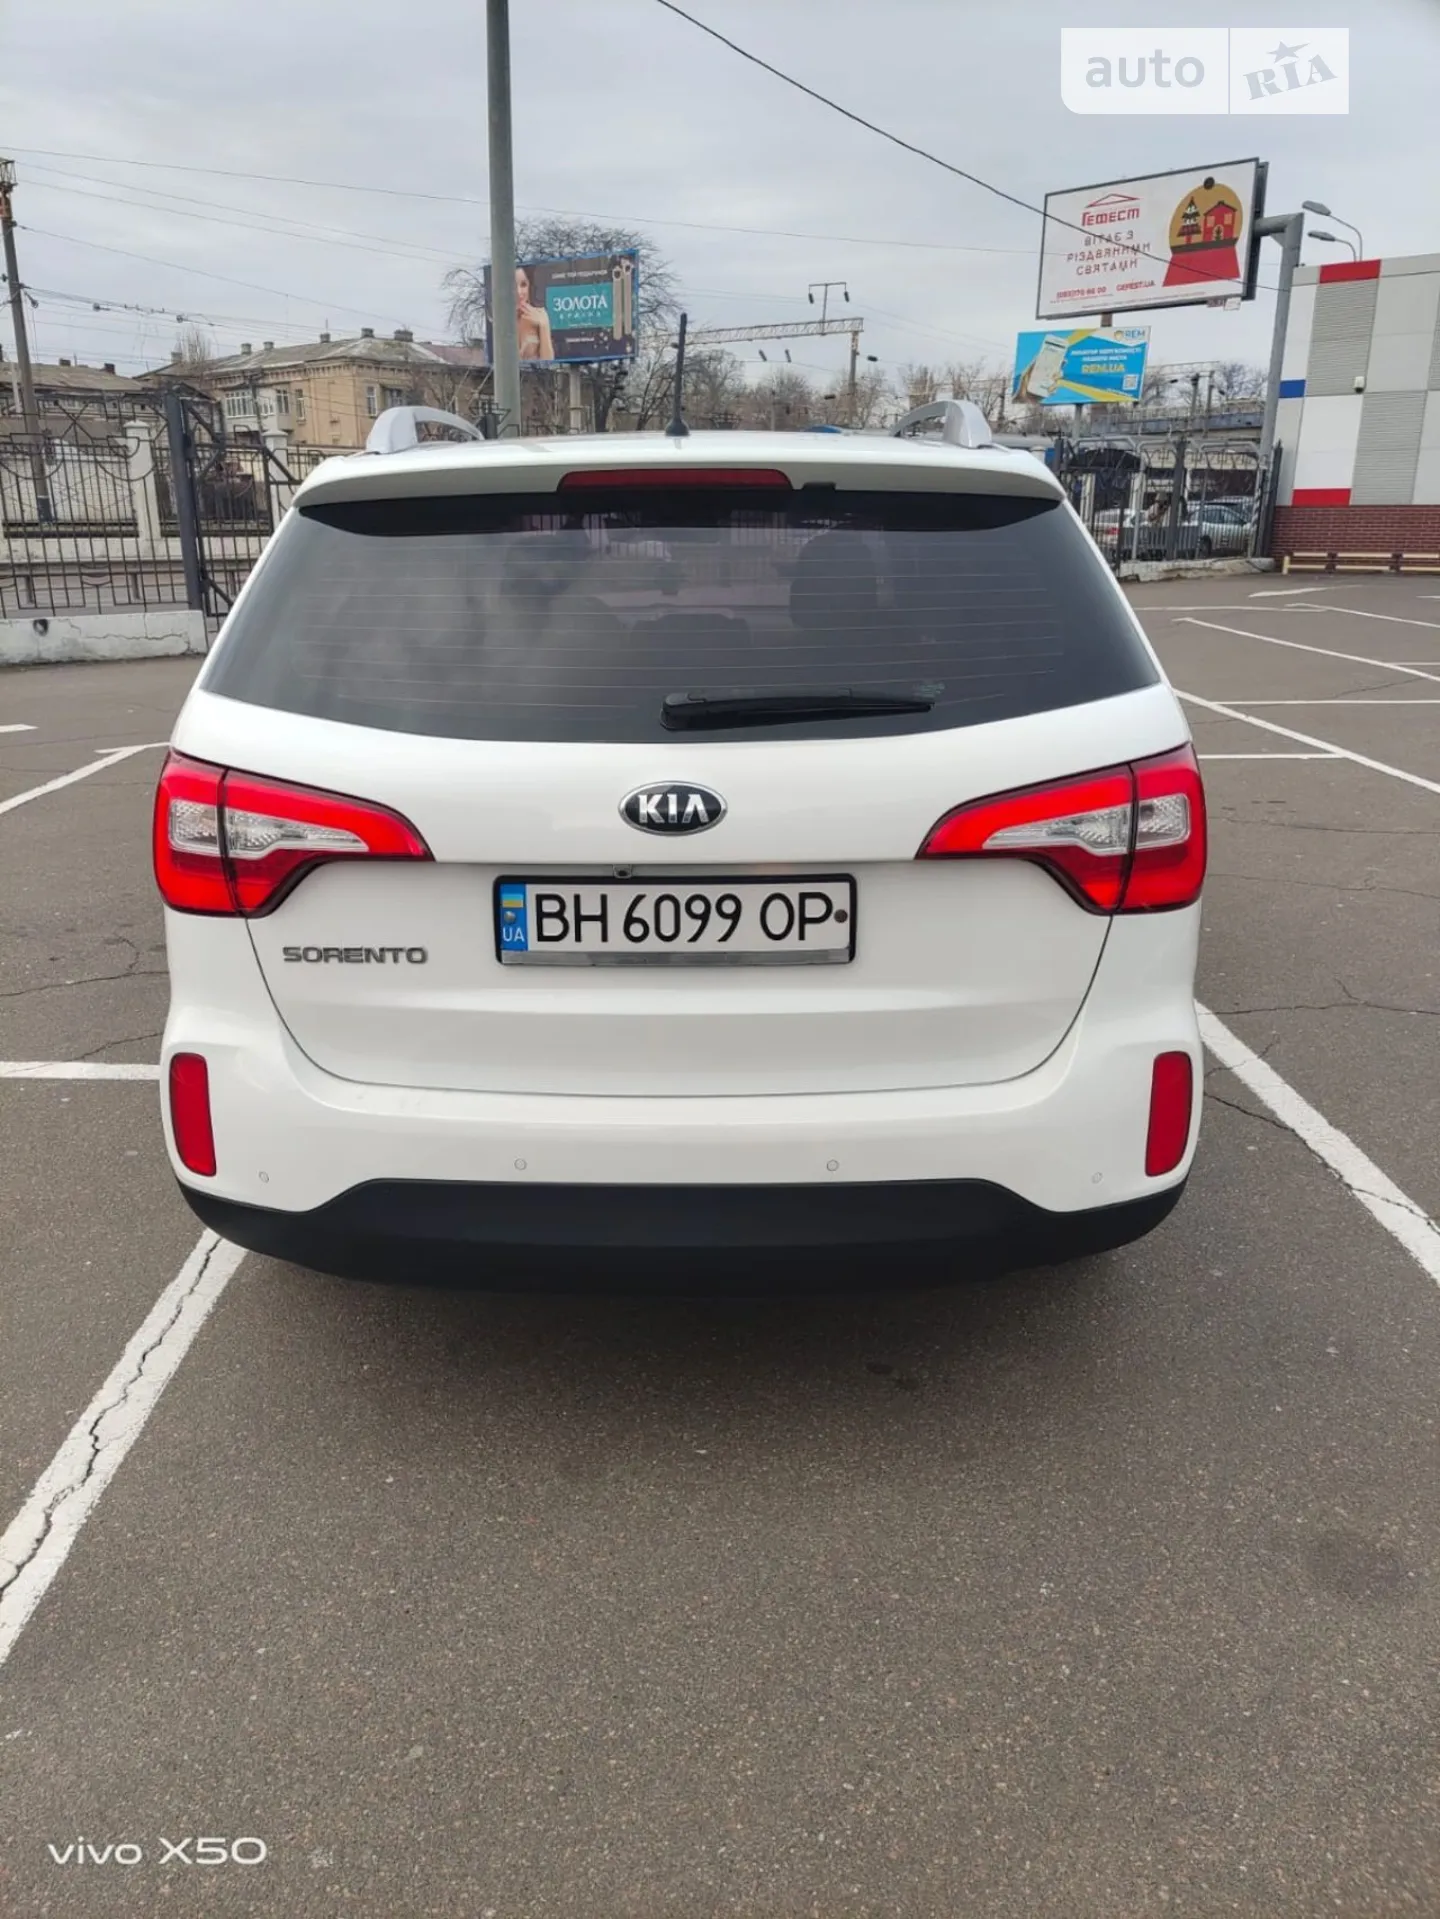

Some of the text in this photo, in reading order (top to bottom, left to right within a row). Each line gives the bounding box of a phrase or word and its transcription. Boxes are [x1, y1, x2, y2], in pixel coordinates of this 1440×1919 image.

[1076, 259, 1138, 276] СВЯТАМИ
[552, 295, 608, 312] ЗОЛОТА
[637, 793, 710, 824] KIA
[535, 892, 833, 943] BH 6099 OP
[502, 926, 525, 943] UA
[283, 946, 428, 964] SORENTO
